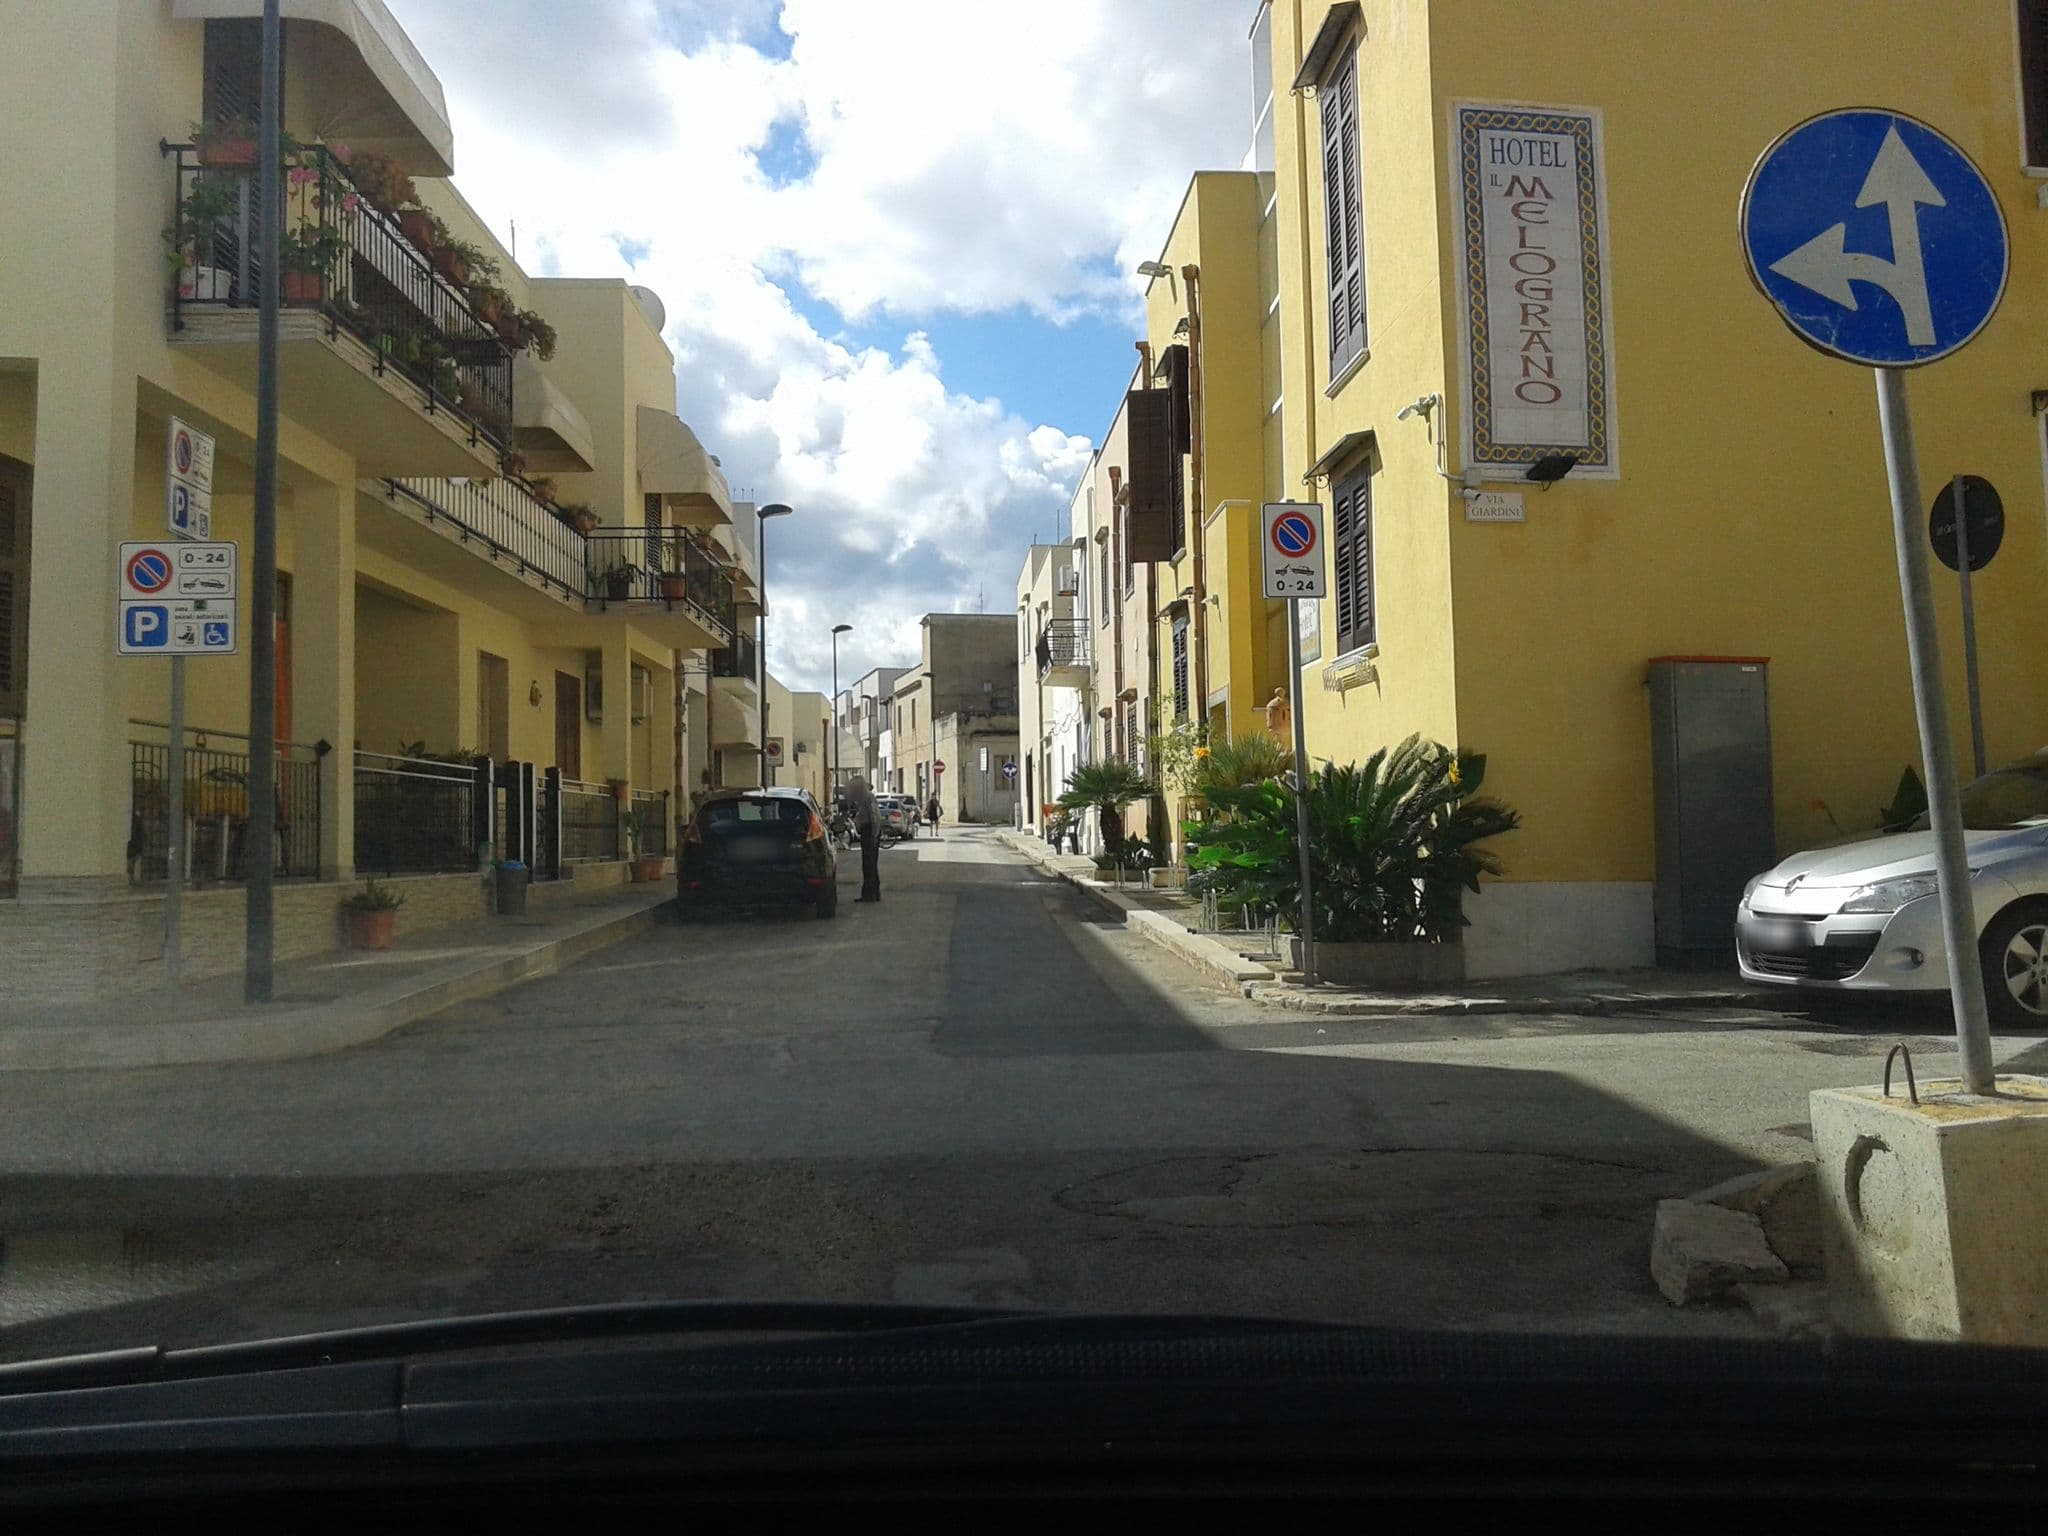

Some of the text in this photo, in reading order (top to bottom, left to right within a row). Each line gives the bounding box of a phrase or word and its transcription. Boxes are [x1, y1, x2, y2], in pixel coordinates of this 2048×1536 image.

[1488, 137, 1567, 168] HOTEL
[1489, 174, 1503, 187] IL
[1503, 174, 1562, 405] MELOGRANO
[1486, 495, 1505, 504] VIA
[1471, 506, 1521, 517] GIARDINI
[134, 611, 160, 643] P
